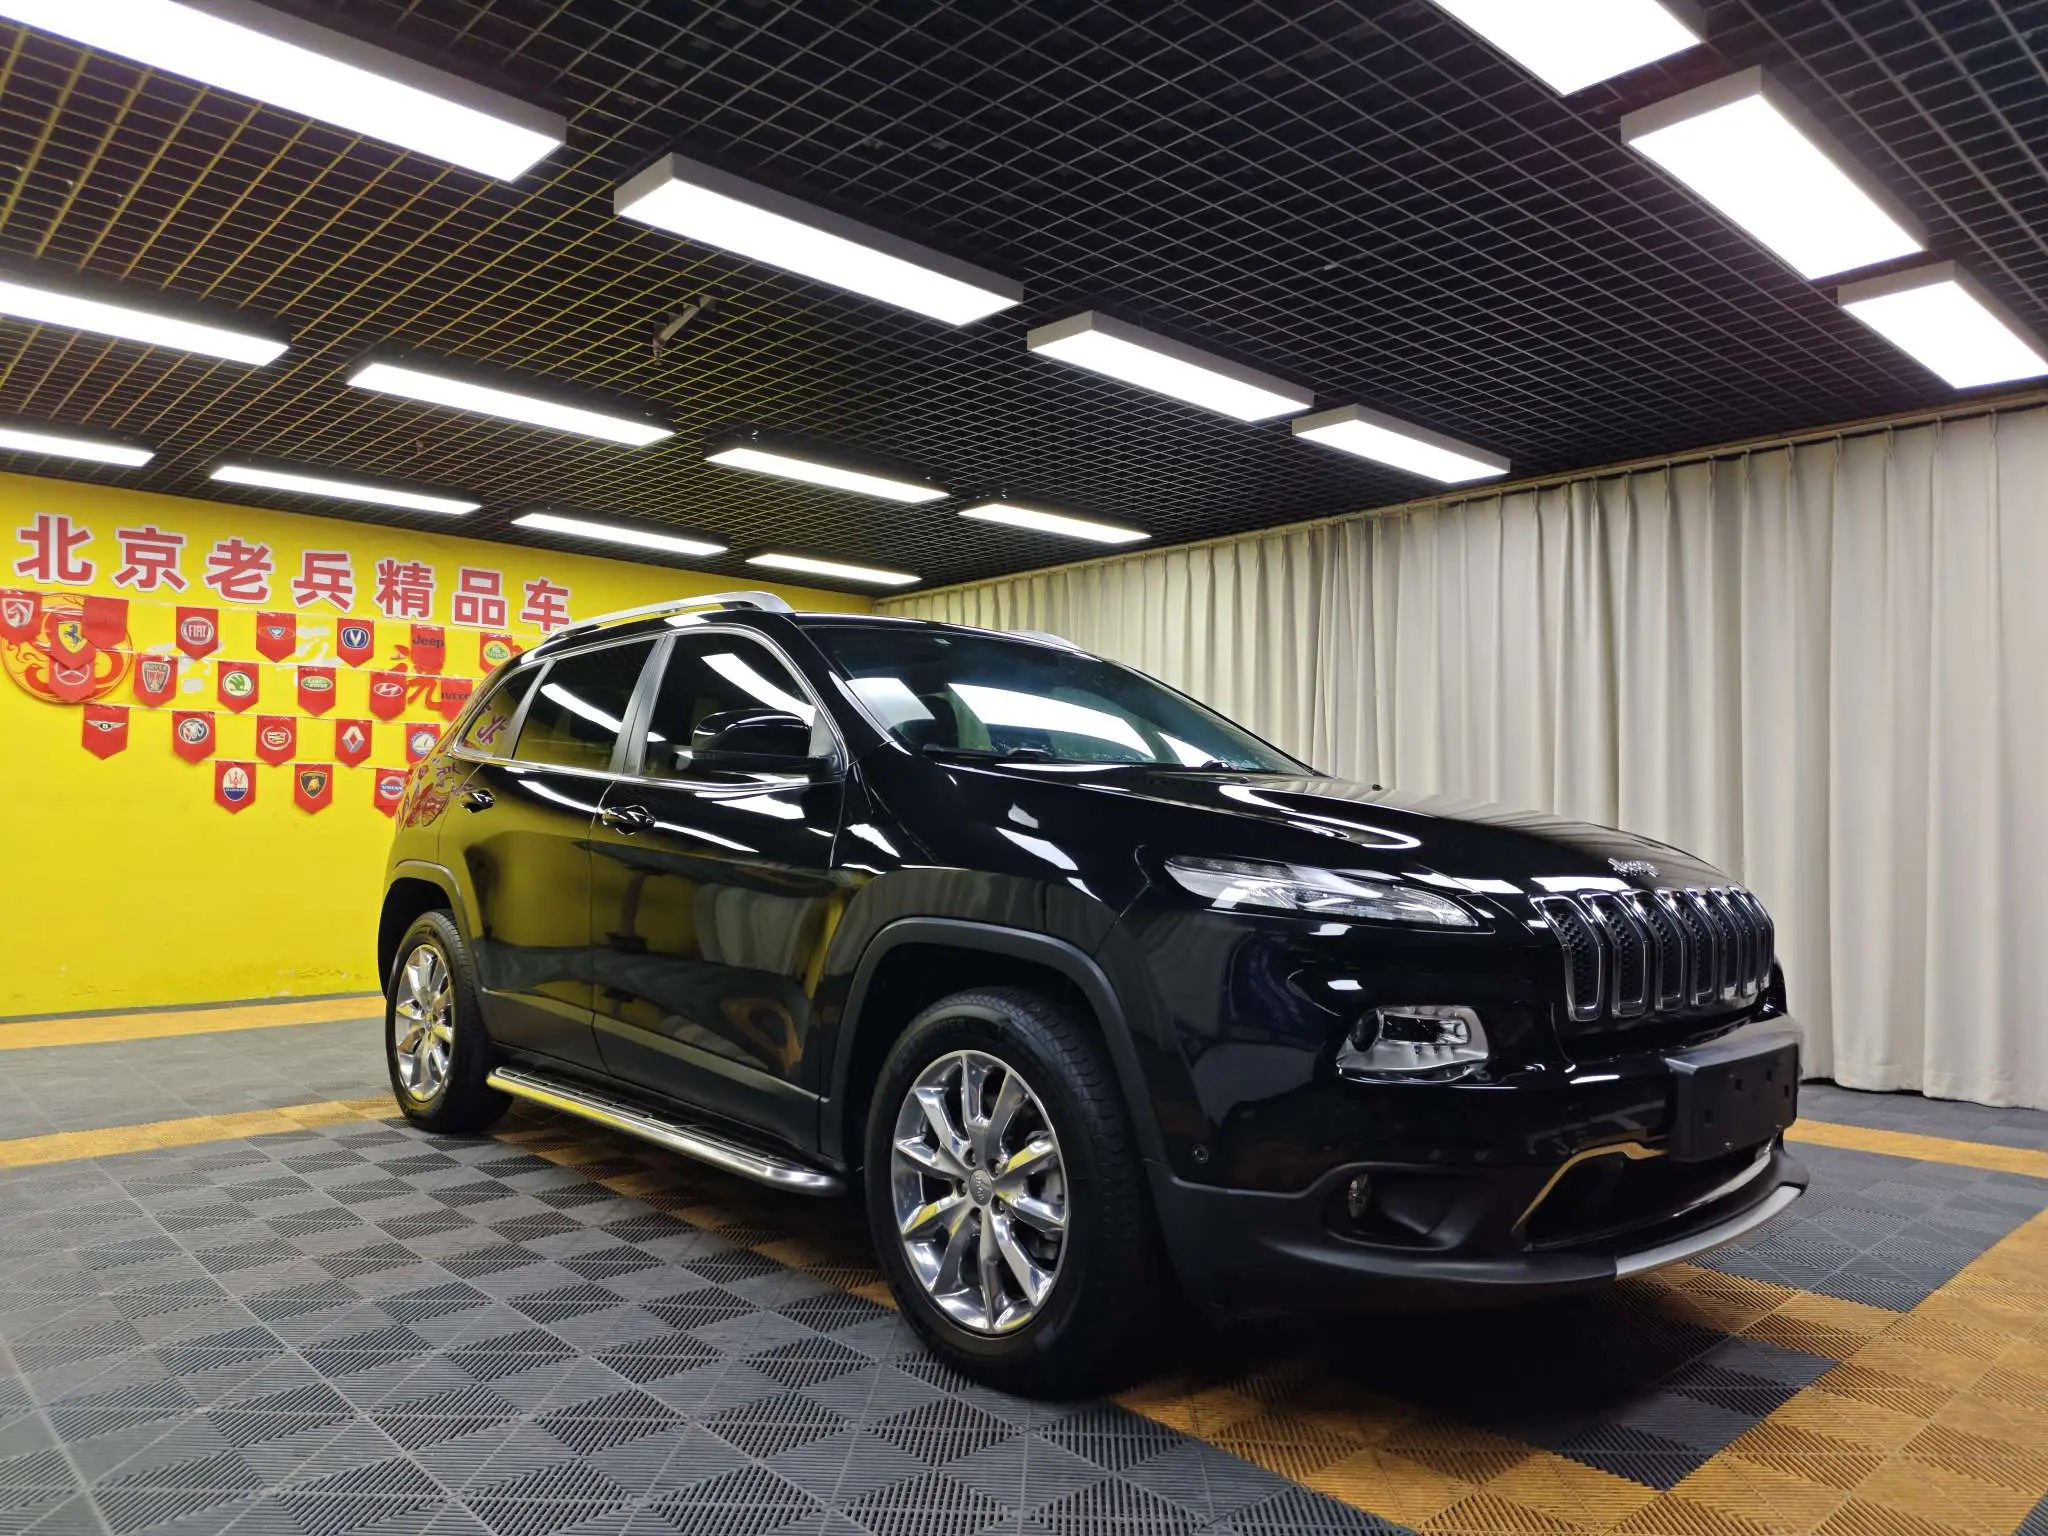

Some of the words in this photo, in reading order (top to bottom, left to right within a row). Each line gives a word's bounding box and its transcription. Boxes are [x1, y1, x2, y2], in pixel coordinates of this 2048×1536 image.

[16, 513, 571, 632] 北京老兵精品车
[188, 624, 207, 638] FIAT
[412, 635, 445, 649] Jeep
